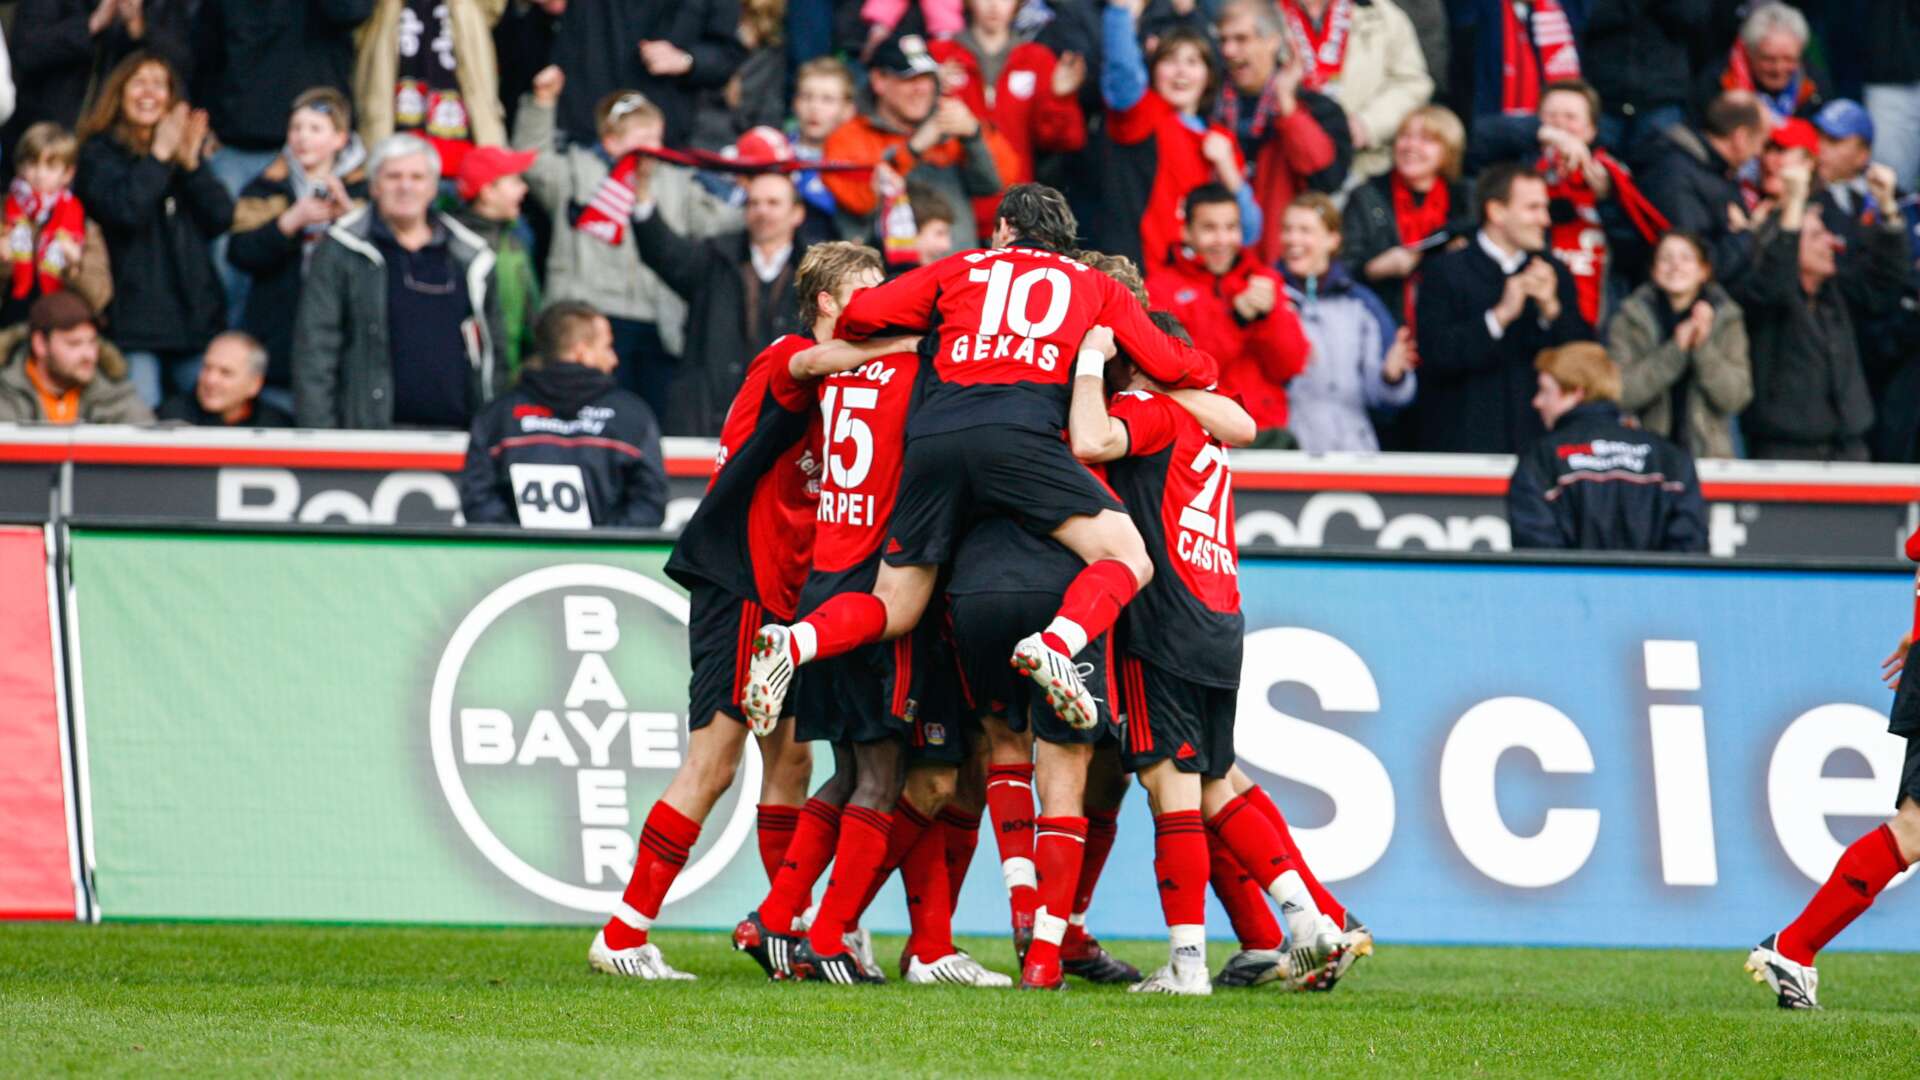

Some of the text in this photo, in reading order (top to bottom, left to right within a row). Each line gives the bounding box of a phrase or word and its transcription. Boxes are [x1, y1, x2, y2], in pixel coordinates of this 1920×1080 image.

[968, 259, 1072, 339] 10
[951, 334, 1060, 371] GEKAS
[820, 385, 879, 489] 15
[521, 480, 582, 513] 40
[460, 708, 690, 768] BAYE
